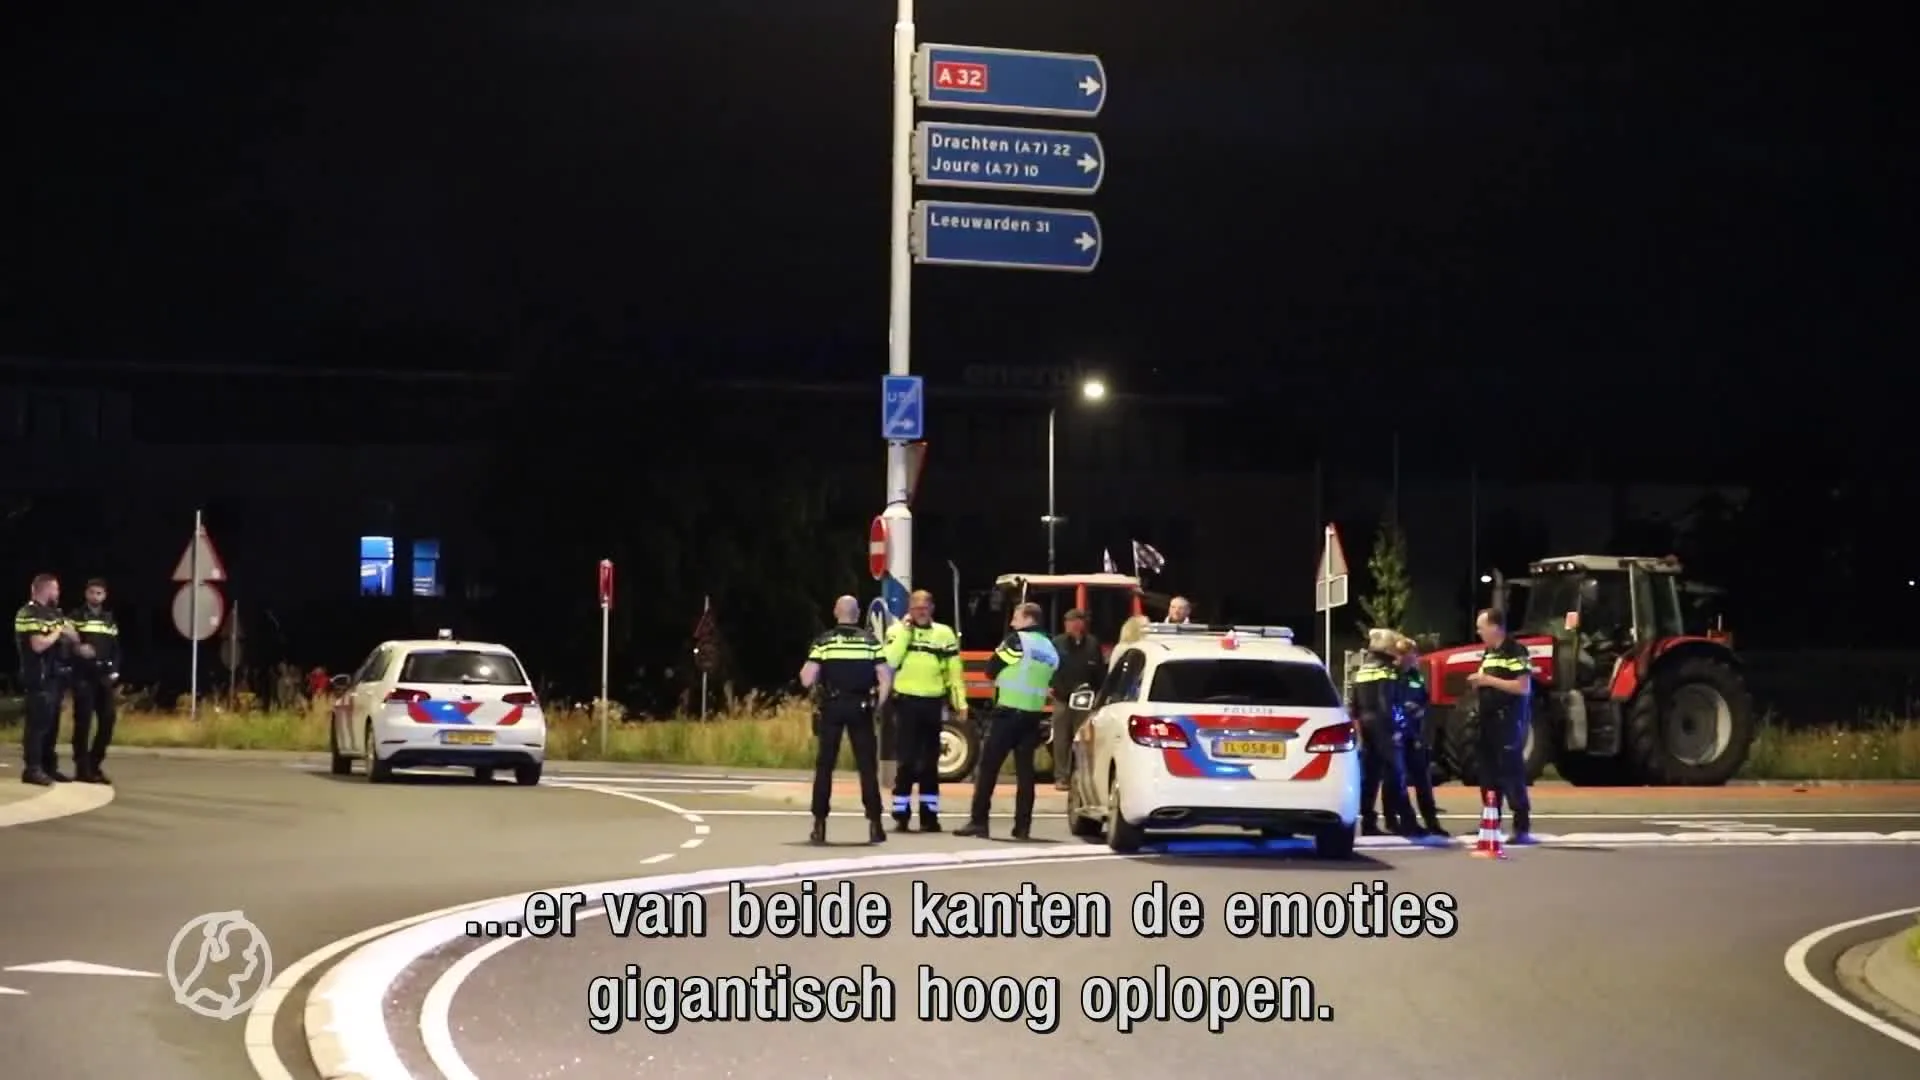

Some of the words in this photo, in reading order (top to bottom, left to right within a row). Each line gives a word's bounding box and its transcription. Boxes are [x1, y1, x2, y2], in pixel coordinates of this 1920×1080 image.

[938, 68, 952, 84] A
[957, 69, 982, 86] 32
[931, 133, 1009, 153] Drachten
[1053, 143, 1071, 156] 22
[931, 157, 980, 173] Joure
[1024, 164, 1039, 177] 10
[930, 212, 1030, 232] Leeuwarden
[1036, 220, 1050, 233] 31
